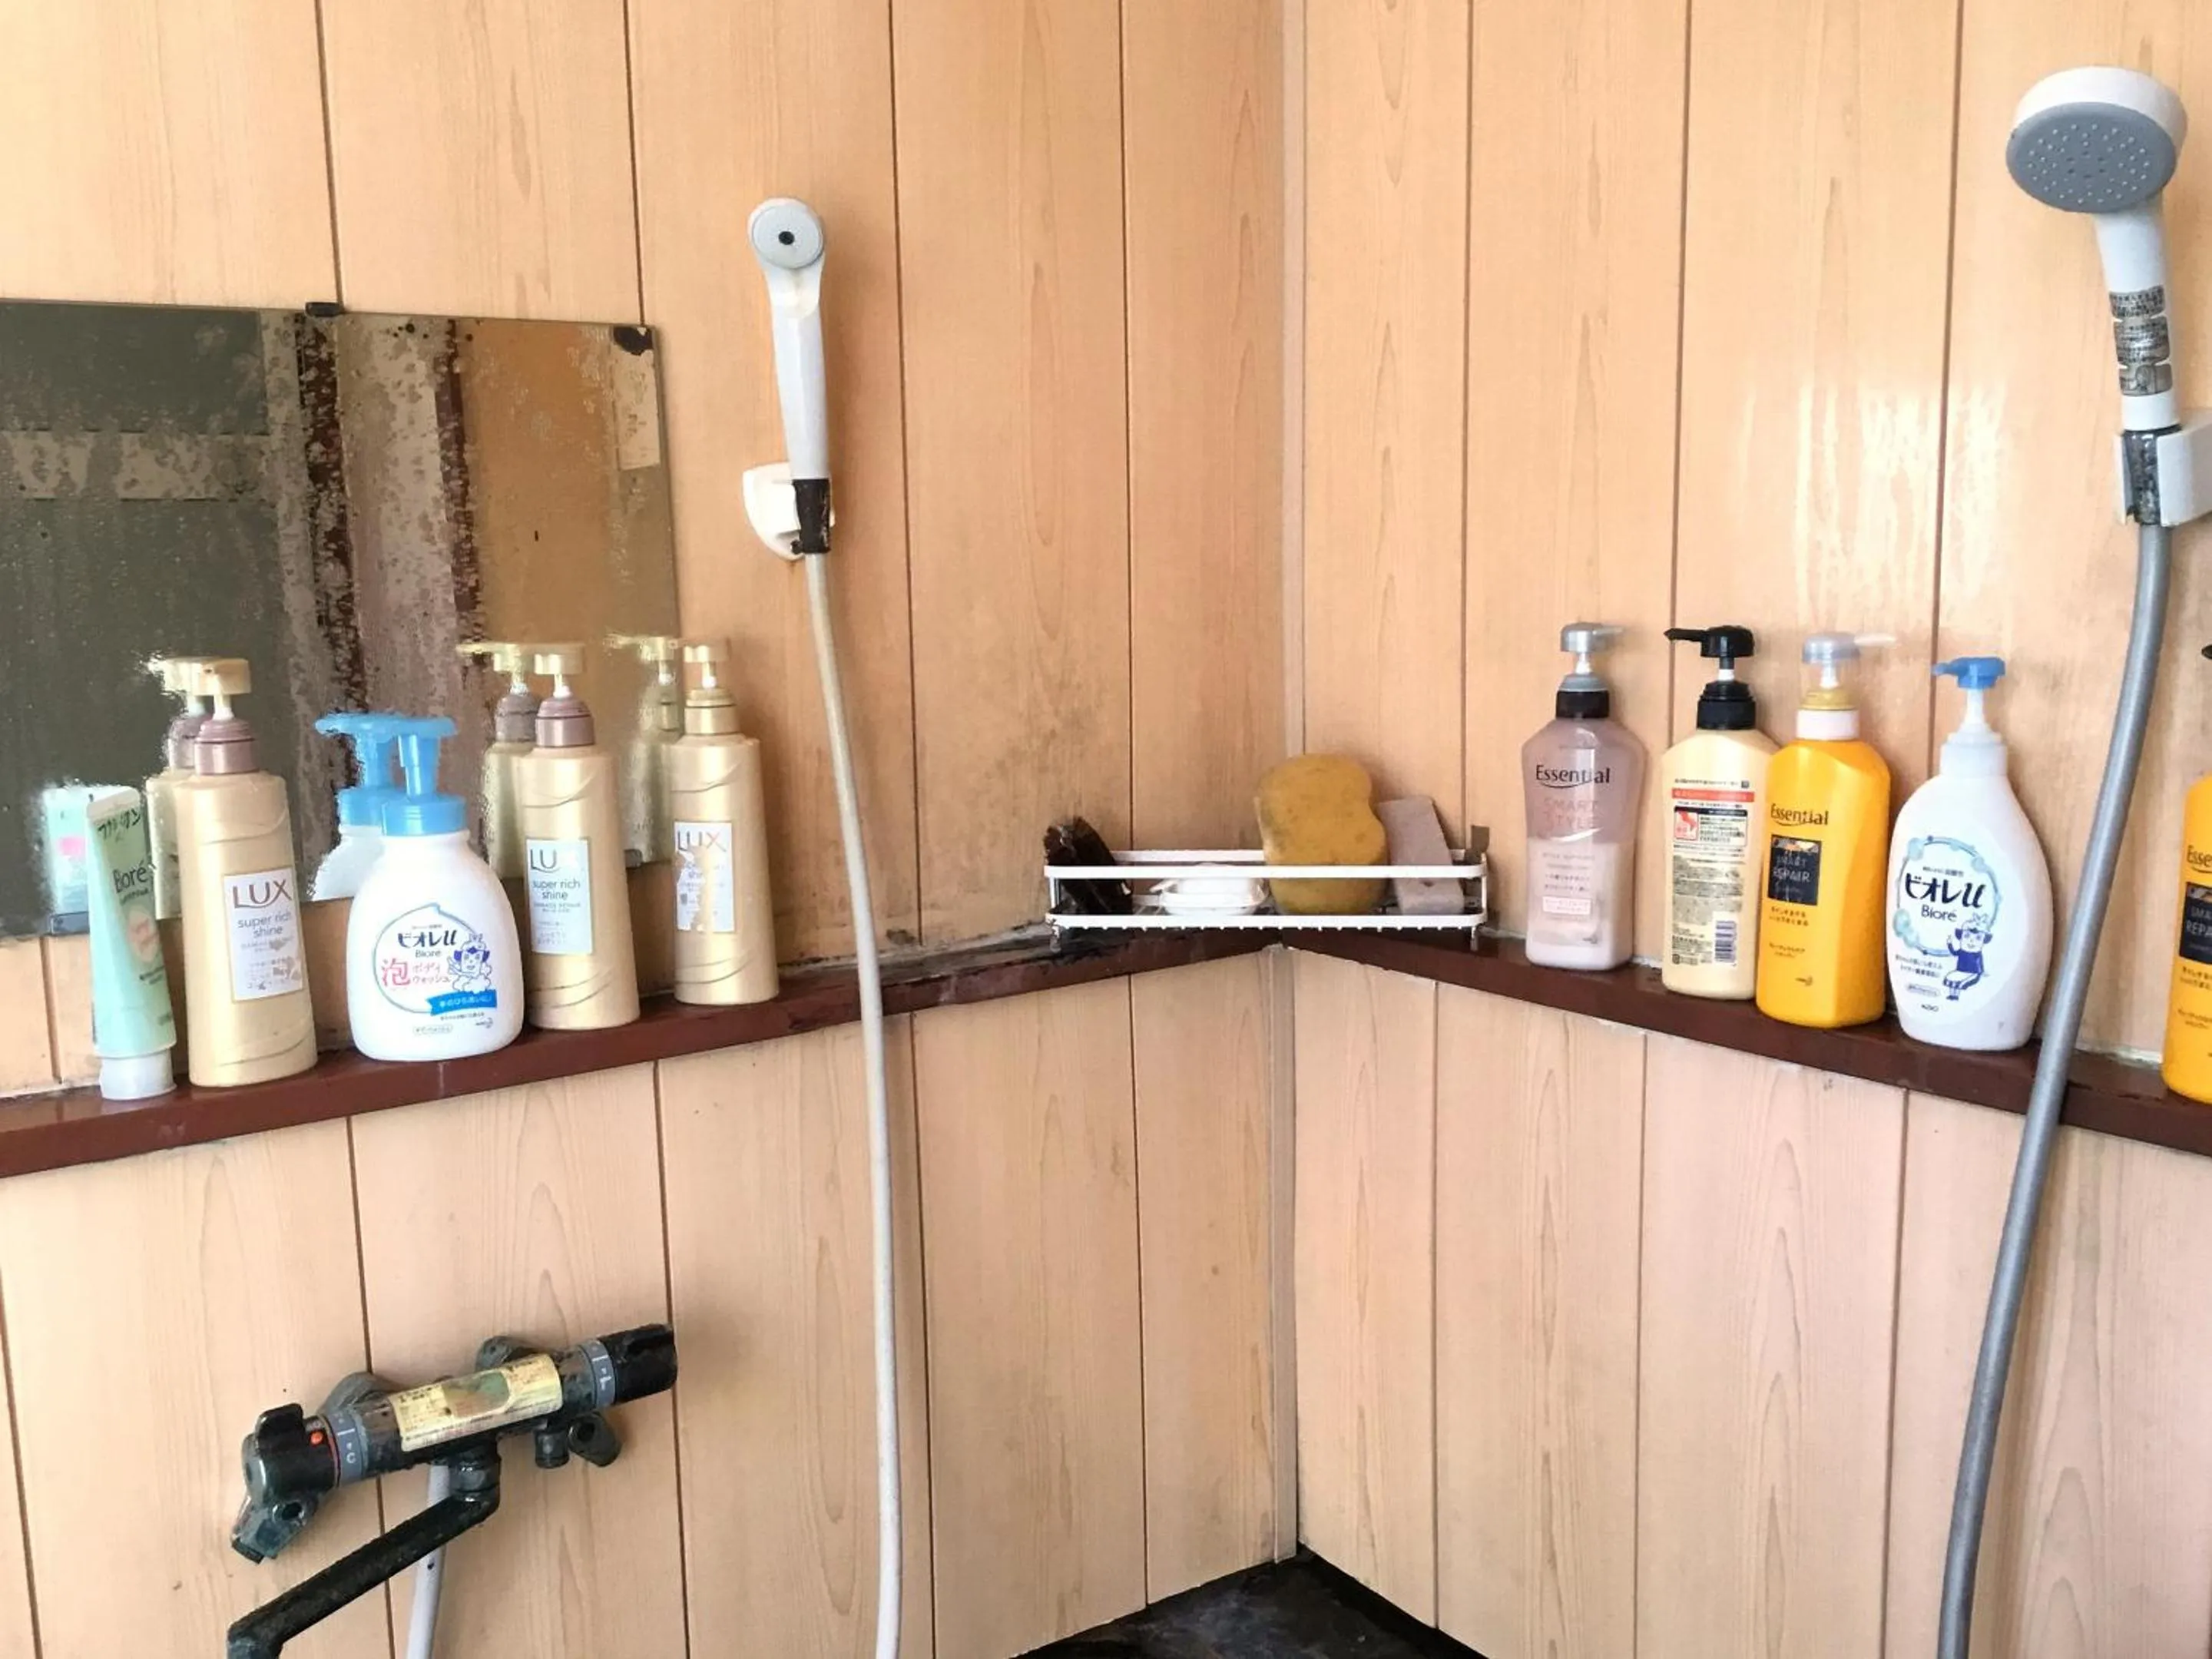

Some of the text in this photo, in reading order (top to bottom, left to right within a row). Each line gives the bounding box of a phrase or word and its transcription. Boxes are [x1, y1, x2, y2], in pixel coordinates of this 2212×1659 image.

[1770, 803, 1829, 826] Essential
[530, 849, 568, 873] LU
[560, 878, 581, 889] rich
[232, 879, 292, 909] LUX
[237, 915, 272, 930] super
[253, 926, 283, 939] shine
